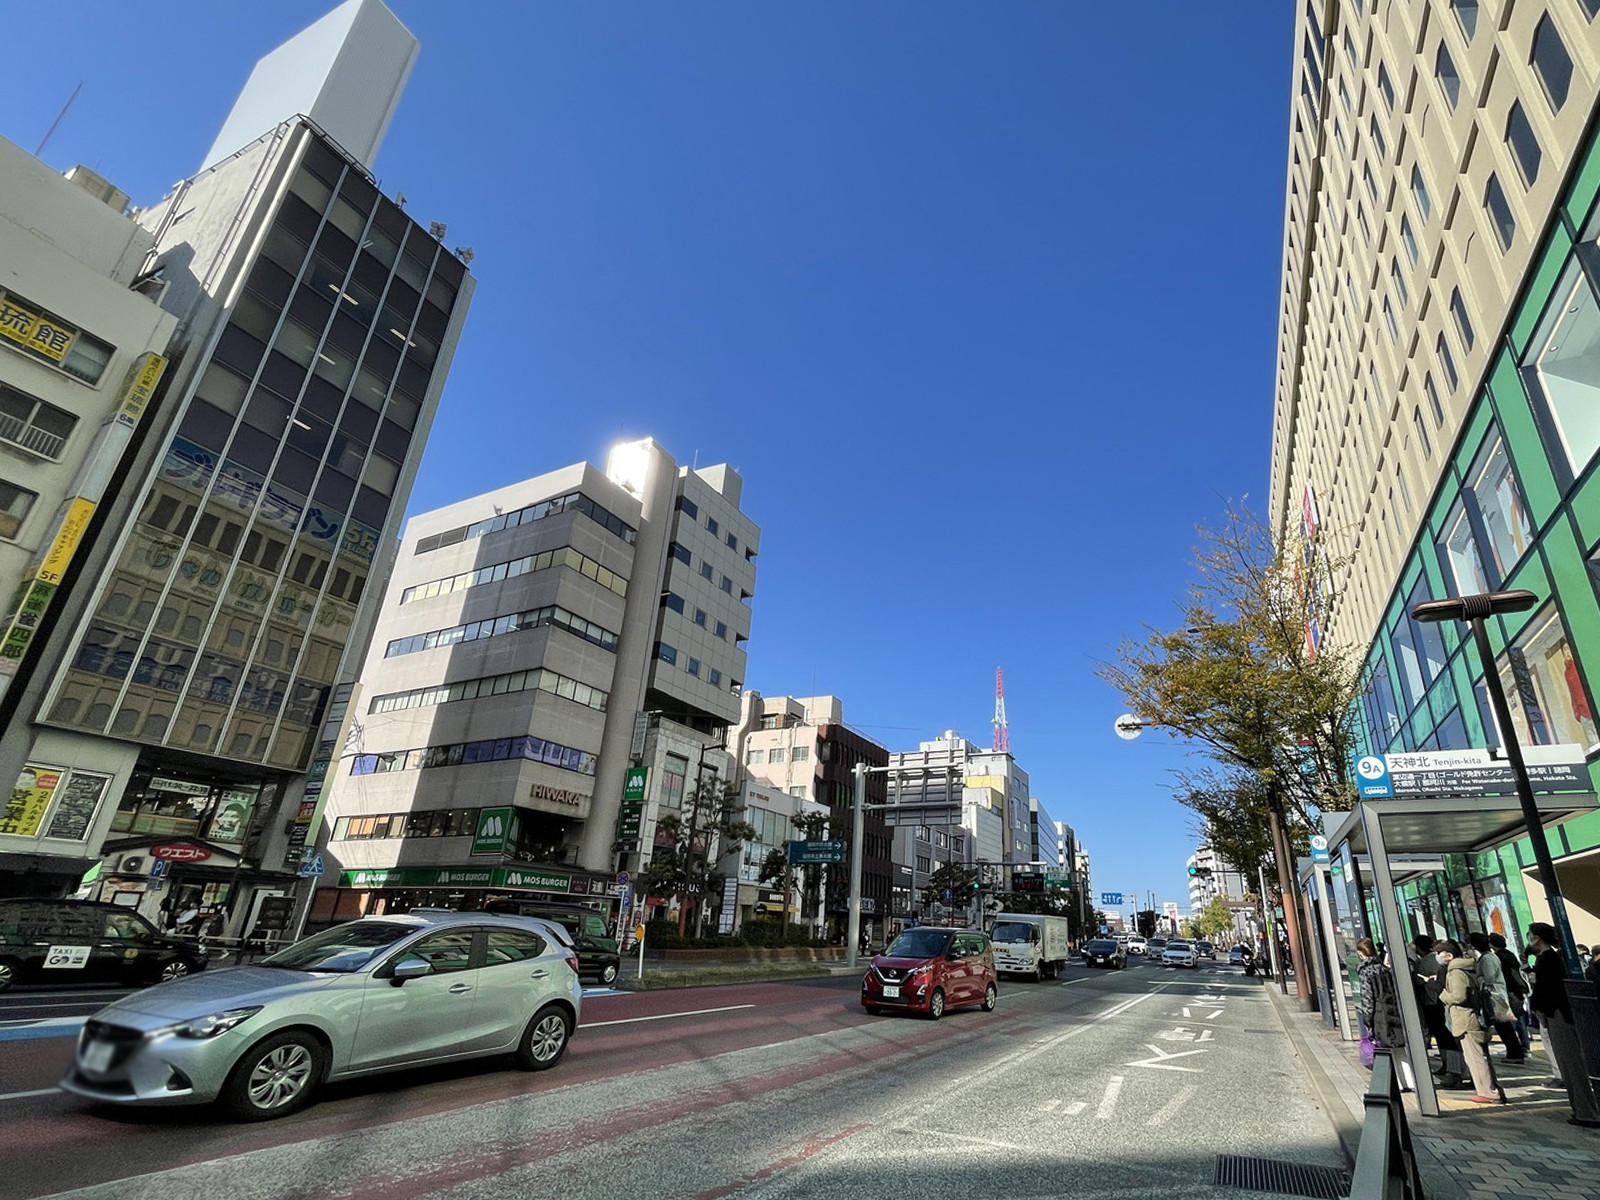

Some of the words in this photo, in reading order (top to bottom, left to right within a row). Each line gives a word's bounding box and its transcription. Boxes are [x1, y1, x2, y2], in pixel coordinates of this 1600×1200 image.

[0, 304, 70, 352] 琉館
[1361, 761, 1382, 774] 9A
[1389, 756, 1430, 770] 天神北
[1433, 757, 1482, 768] Tenjin-kita
[530, 784, 582, 806] HIWAKA
[159, 847, 205, 858] ウエスト
[153, 861, 164, 875] P
[465, 873, 490, 882] BURGER
[523, 876, 541, 884] MOS
[541, 877, 568, 887] BURGER
